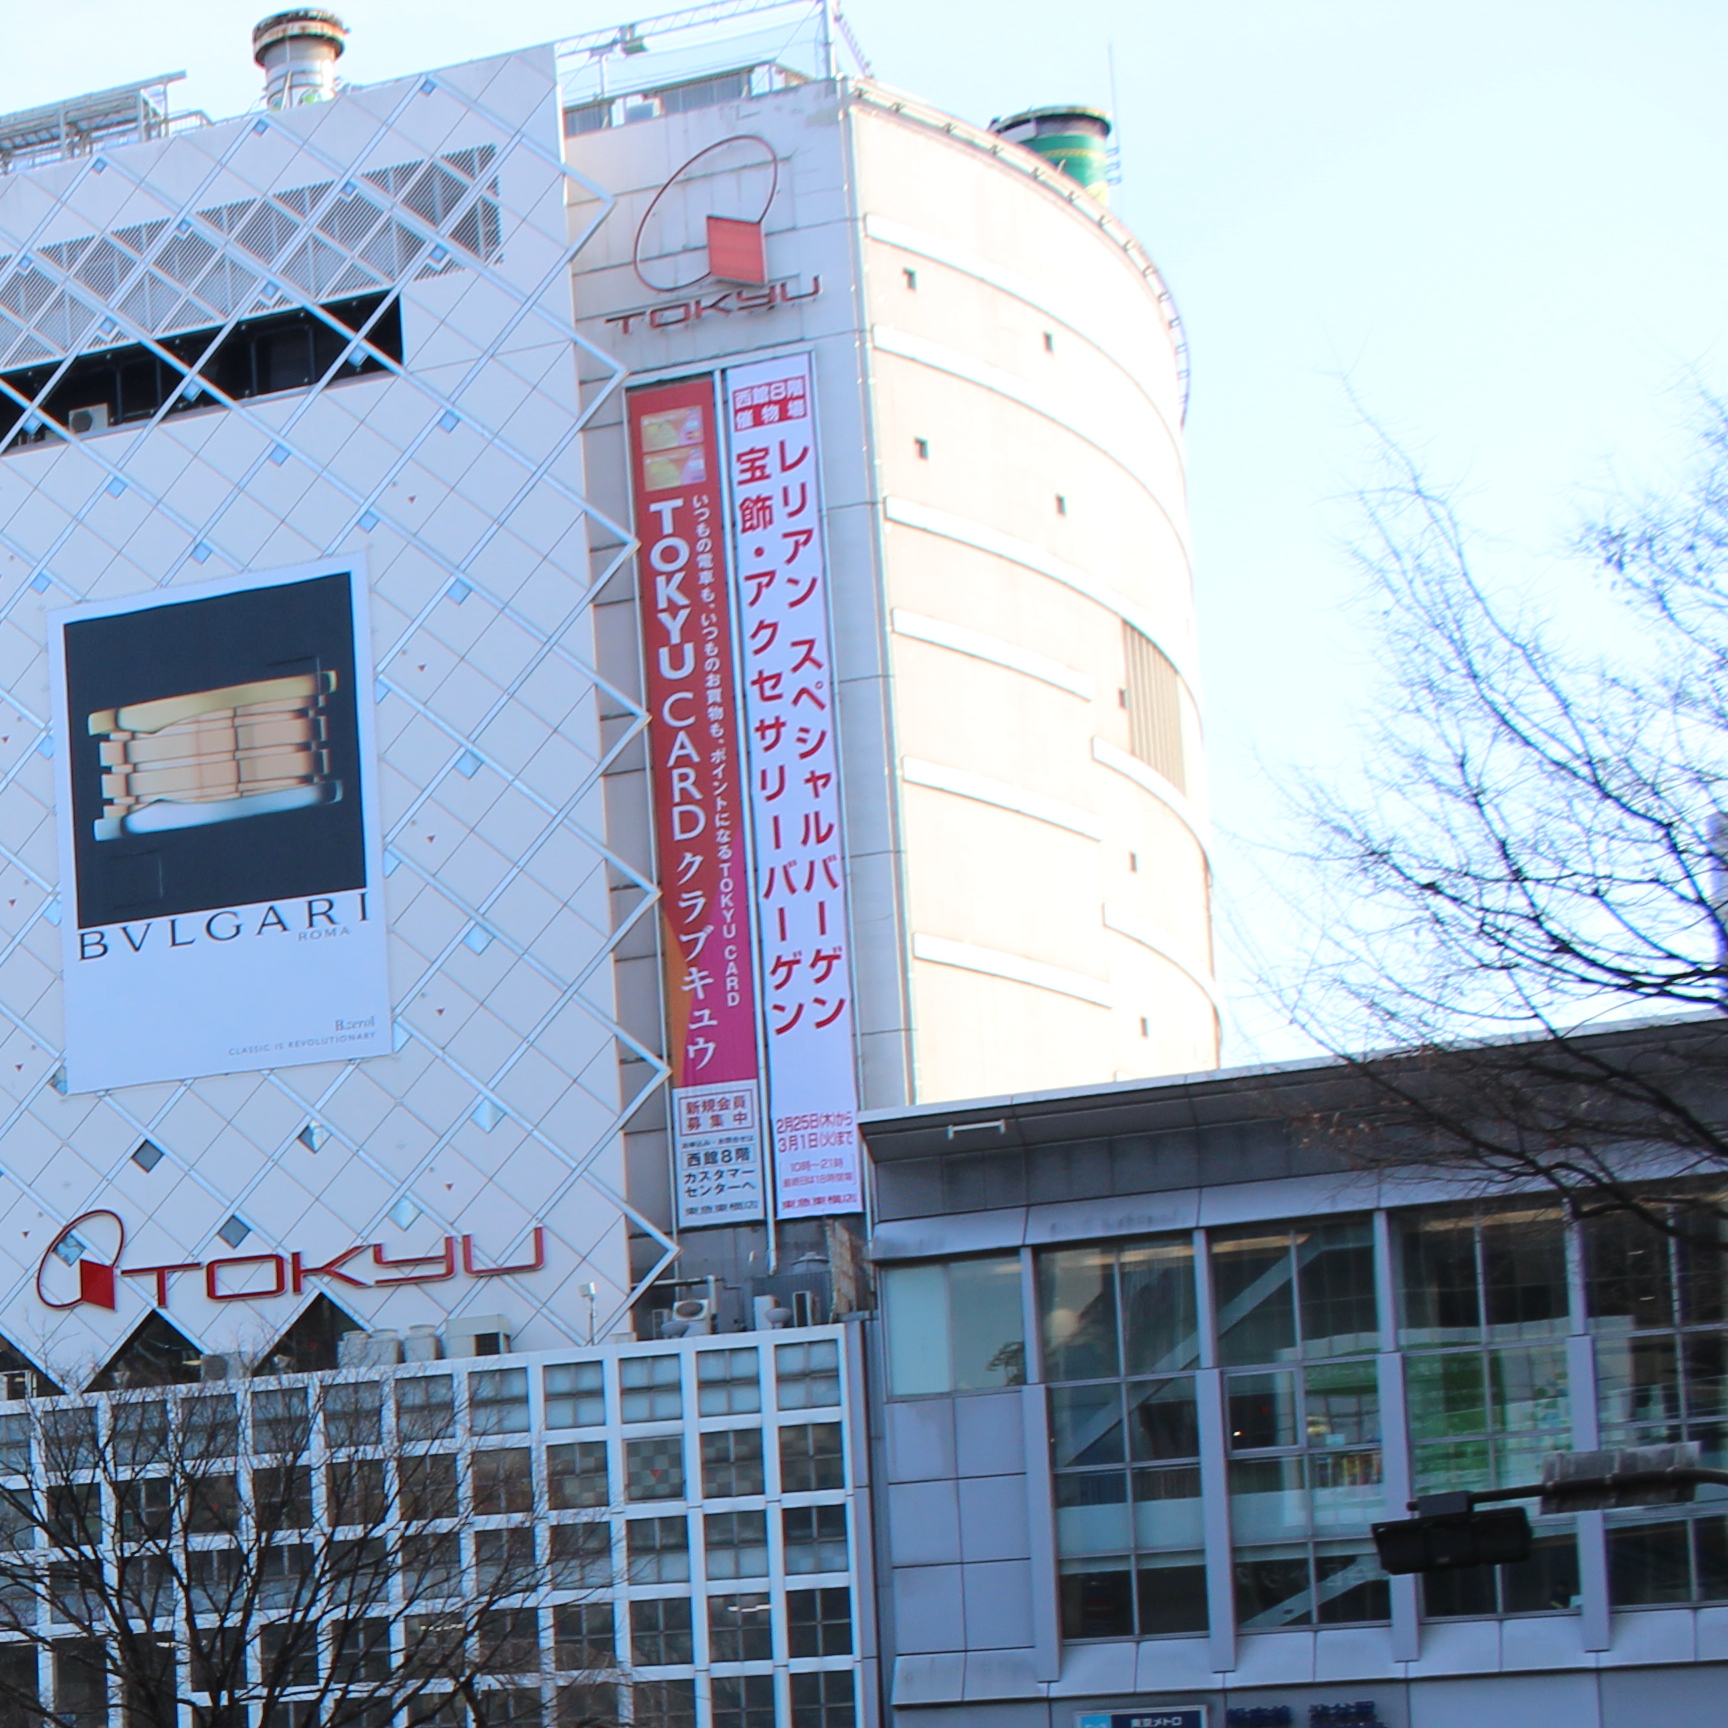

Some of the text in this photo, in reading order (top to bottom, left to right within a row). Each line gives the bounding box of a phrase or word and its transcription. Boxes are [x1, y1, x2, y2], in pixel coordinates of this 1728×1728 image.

[604, 275, 823, 335] TOKYU
[649, 497, 697, 681] TOKYU
[661, 691, 707, 843] CARD
[789, 638, 847, 1030] スペシャルバーゲン
[77, 891, 371, 962] BVLGARI
[718, 862, 737, 940] TOKYU
[297, 925, 352, 944] ROMA
[724, 945, 741, 1008] CARD
[228, 1031, 377, 1056] CLASSIC IS REVOLUTIONARY
[684, 1167, 755, 1184] カスタマー
[684, 1182, 756, 1199] センターへ
[120, 1226, 545, 1310] TOKYU
[1130, 1716, 1183, 1728] 東京メトロ
